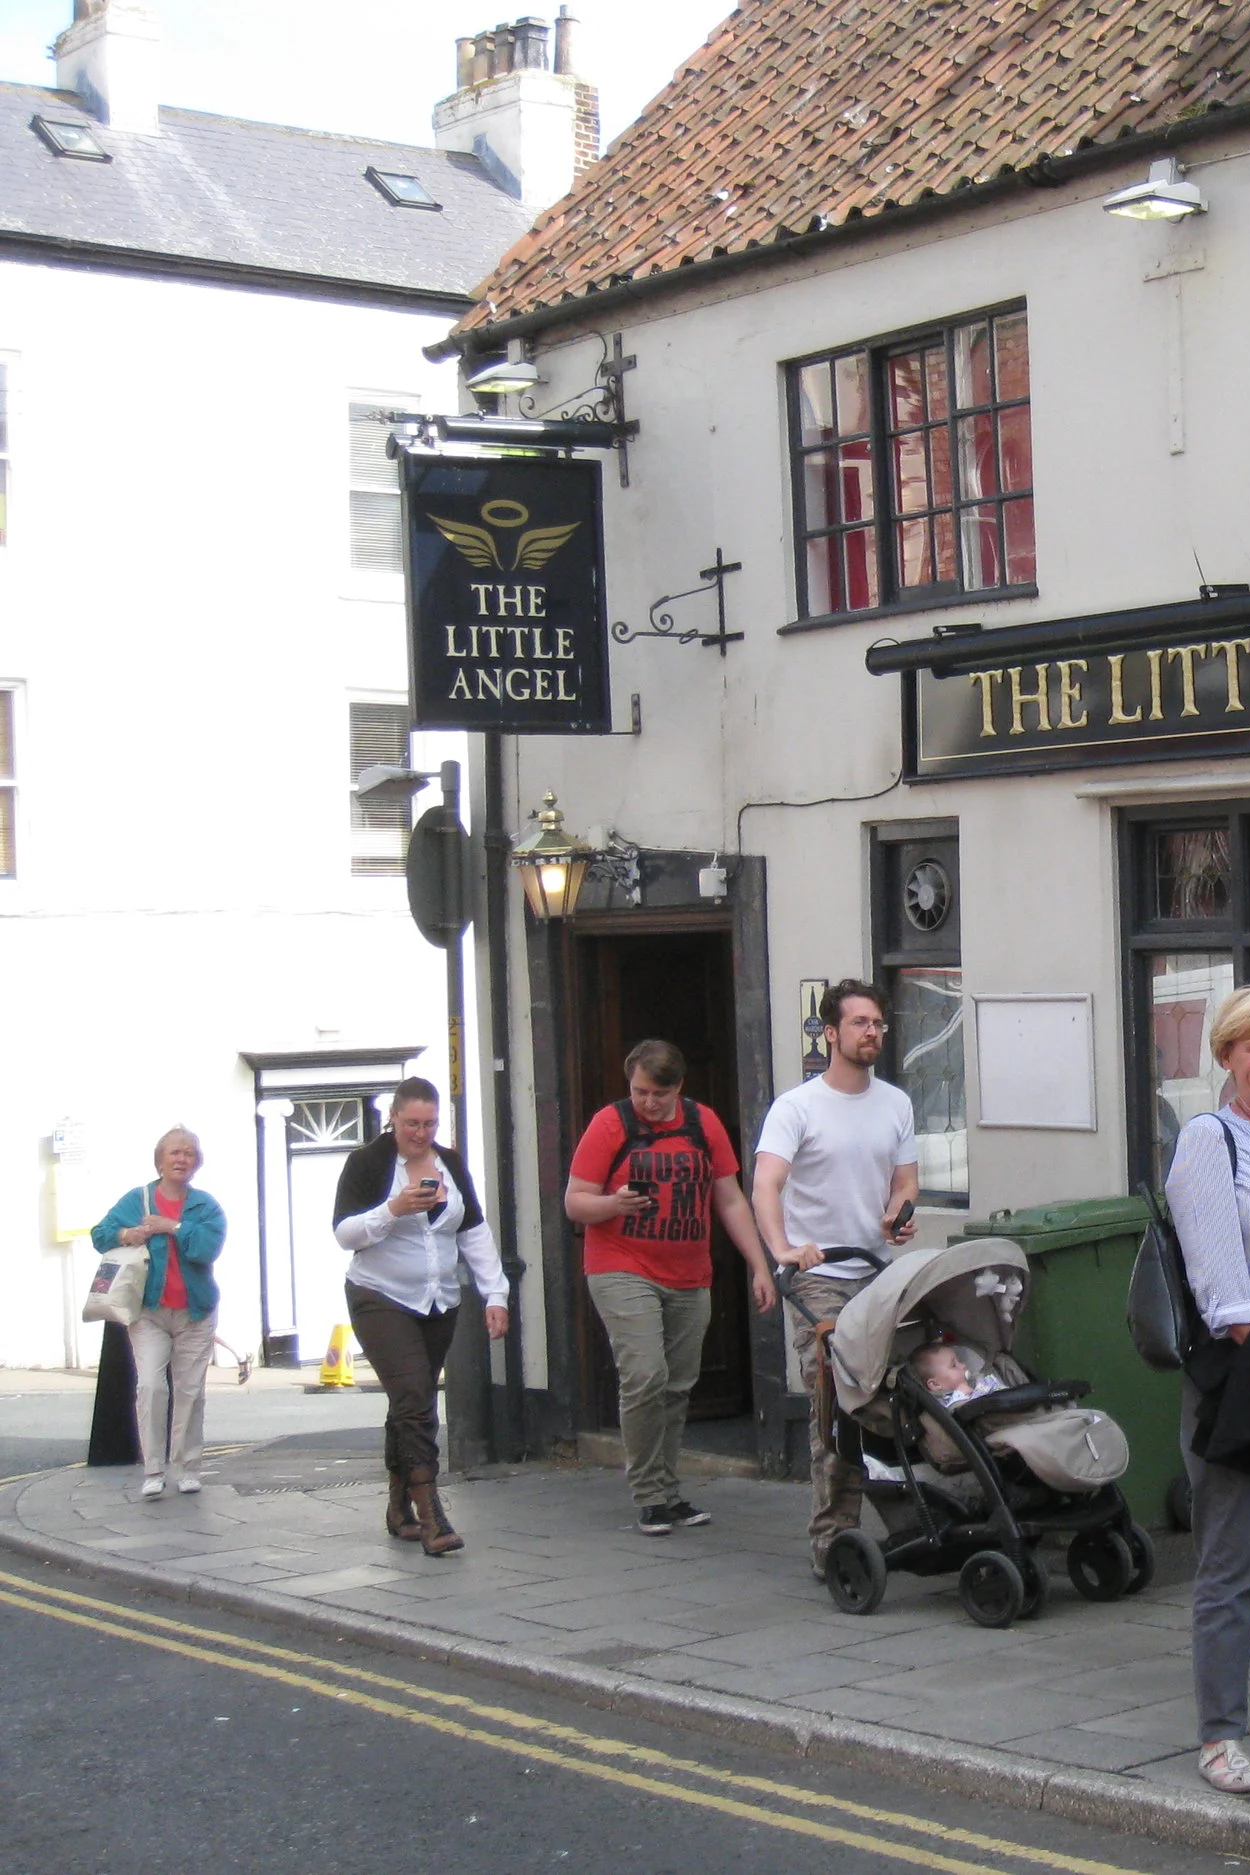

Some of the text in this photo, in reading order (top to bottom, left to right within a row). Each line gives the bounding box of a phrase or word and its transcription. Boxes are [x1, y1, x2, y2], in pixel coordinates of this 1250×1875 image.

[470, 583, 547, 617] THE
[445, 625, 575, 660] LITTLE
[448, 667, 577, 701] ANGEL
[968, 659, 1089, 738] THE
